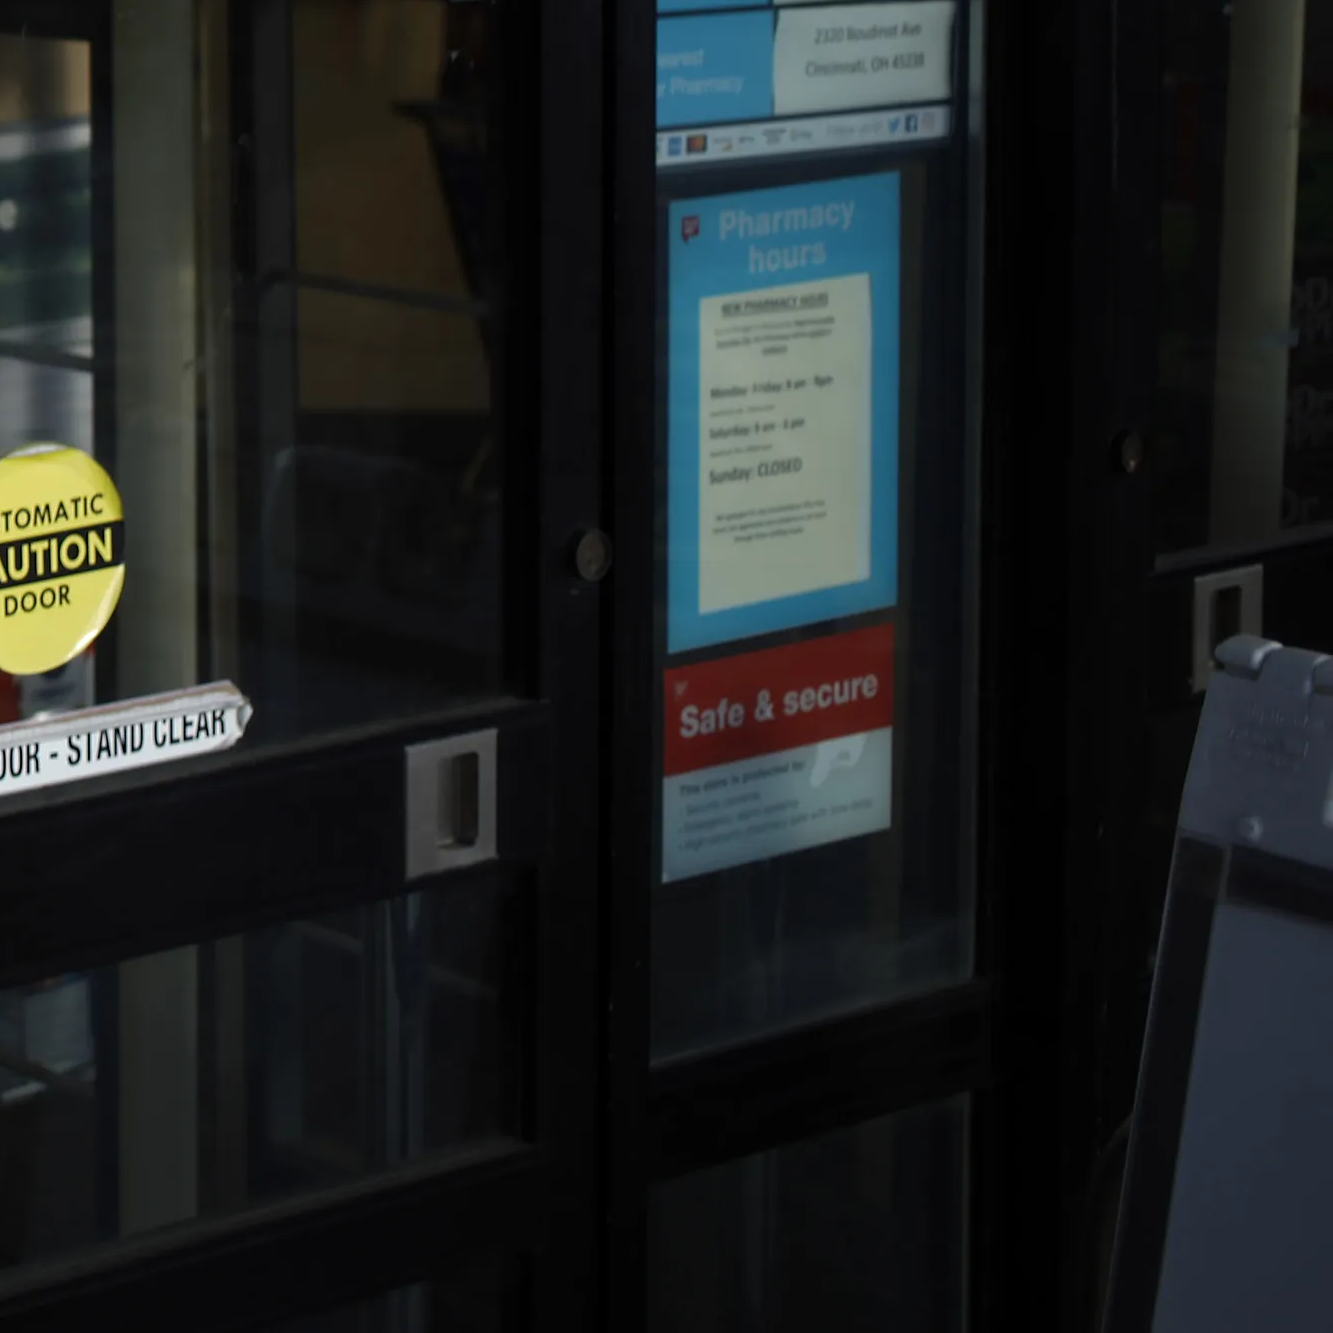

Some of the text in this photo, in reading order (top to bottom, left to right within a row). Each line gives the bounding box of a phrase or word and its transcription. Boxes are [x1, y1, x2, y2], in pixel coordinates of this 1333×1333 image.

[718, 200, 856, 242] Pharmacy
[749, 241, 827, 274] hours
[757, 456, 803, 477] CLOSED
[4, 584, 71, 618] DOOR
[680, 673, 878, 738] Safe & secure
[67, 721, 144, 765] STAND
[153, 709, 226, 749] CLEAR
